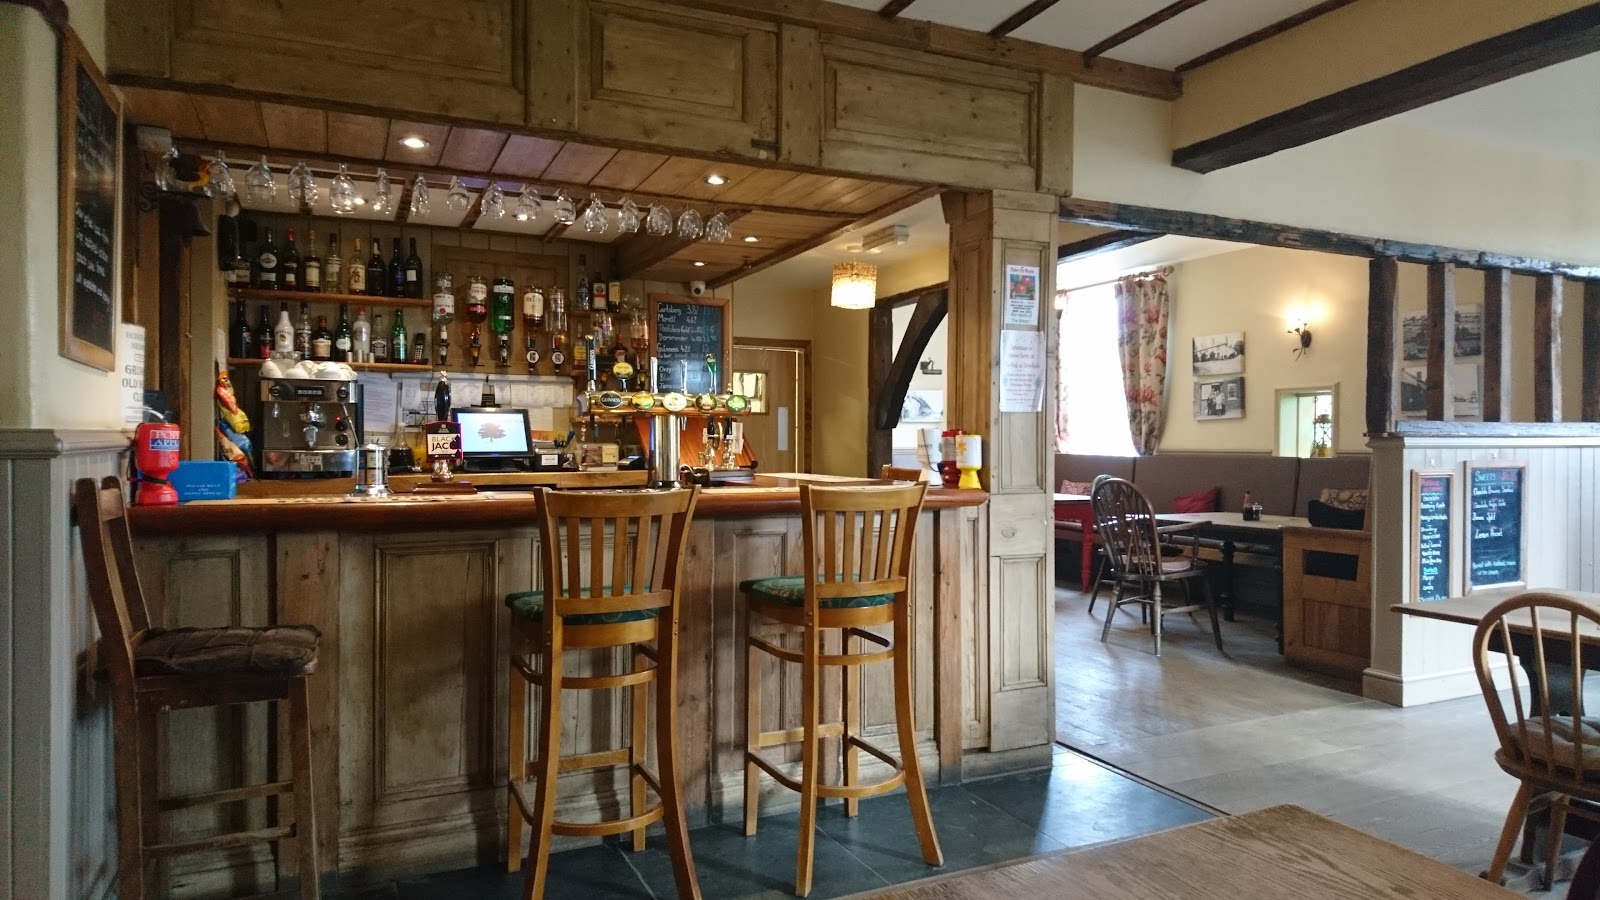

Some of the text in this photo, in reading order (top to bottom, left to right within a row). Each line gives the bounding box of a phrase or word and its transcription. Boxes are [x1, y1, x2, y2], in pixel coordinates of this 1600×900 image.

[658, 303, 682, 316] Carlsberg
[658, 313, 676, 323] Moretti
[657, 343, 680, 353] Guinness
[122, 378, 138, 388] OLD
[431, 442, 454, 452] JAC
